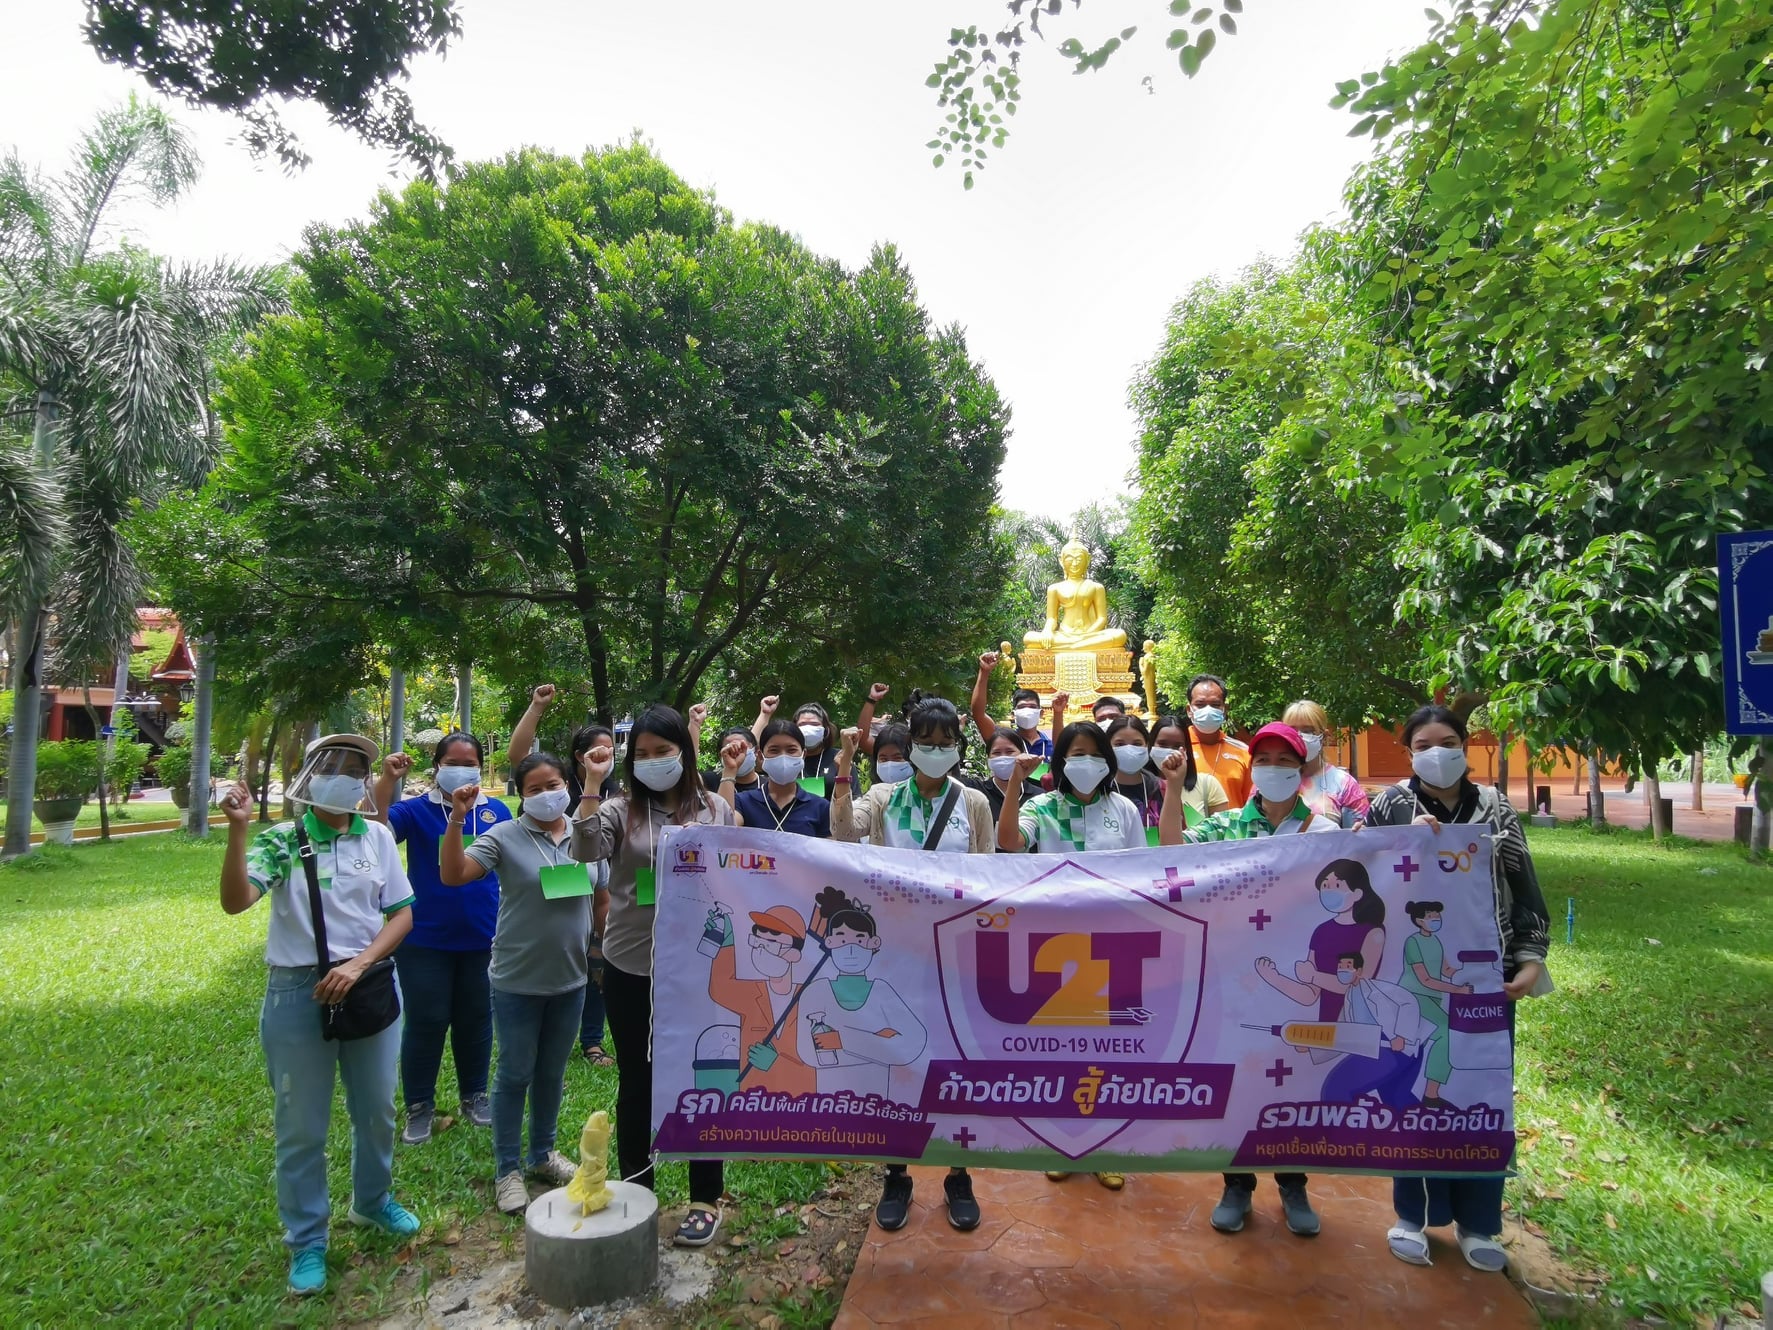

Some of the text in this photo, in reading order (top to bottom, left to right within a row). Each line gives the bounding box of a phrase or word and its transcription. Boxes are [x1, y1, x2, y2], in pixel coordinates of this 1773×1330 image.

[1103, 816, 1120, 833] 89
[975, 931, 1162, 1026] U2T
[1455, 1006, 1504, 1019] VACCINE
[1002, 1036, 1146, 1054] COVID-19 WEEK
[938, 1071, 1065, 1103] ก้าวต่อไป
[680, 1091, 721, 1124] รุก
[1261, 1098, 1500, 1132] รวมพลัง ฉีดวัคซีน
[699, 1124, 886, 1150] สร้างความปลอดภัยในชุมชน
[1256, 1136, 1500, 1160] หยุดเชื้อเพื่อชาติ ลดการระบาดโควิด
